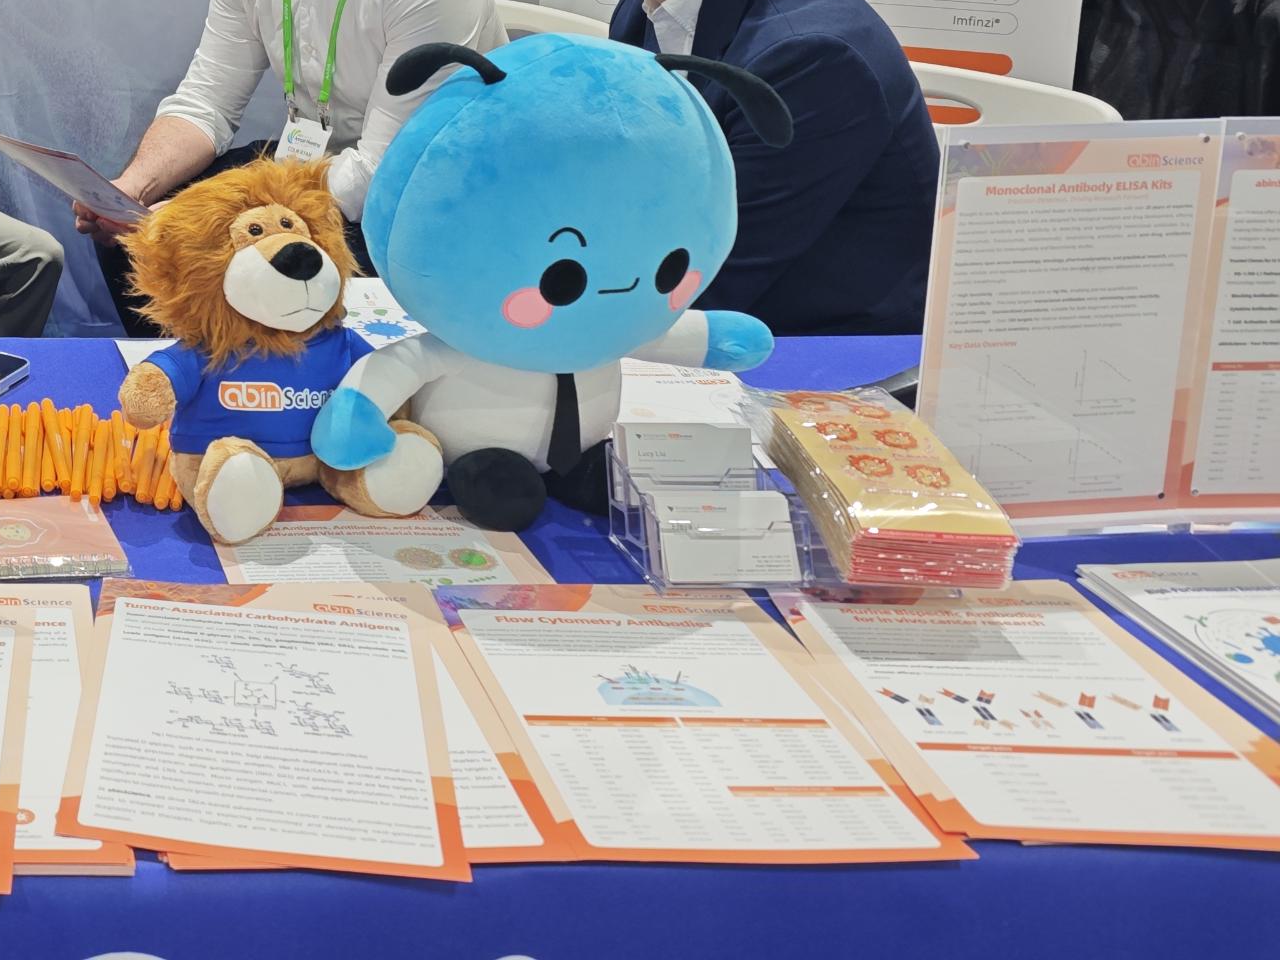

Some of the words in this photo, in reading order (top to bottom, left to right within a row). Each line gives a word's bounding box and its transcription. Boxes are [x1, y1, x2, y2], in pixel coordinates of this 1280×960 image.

[986, 183, 1055, 196] Monoclonal
[1058, 182, 1113, 195] Antibody
[1116, 180, 1148, 190] ELISA
[1151, 179, 1173, 189] Kits
[219, 382, 334, 410] abinScien
